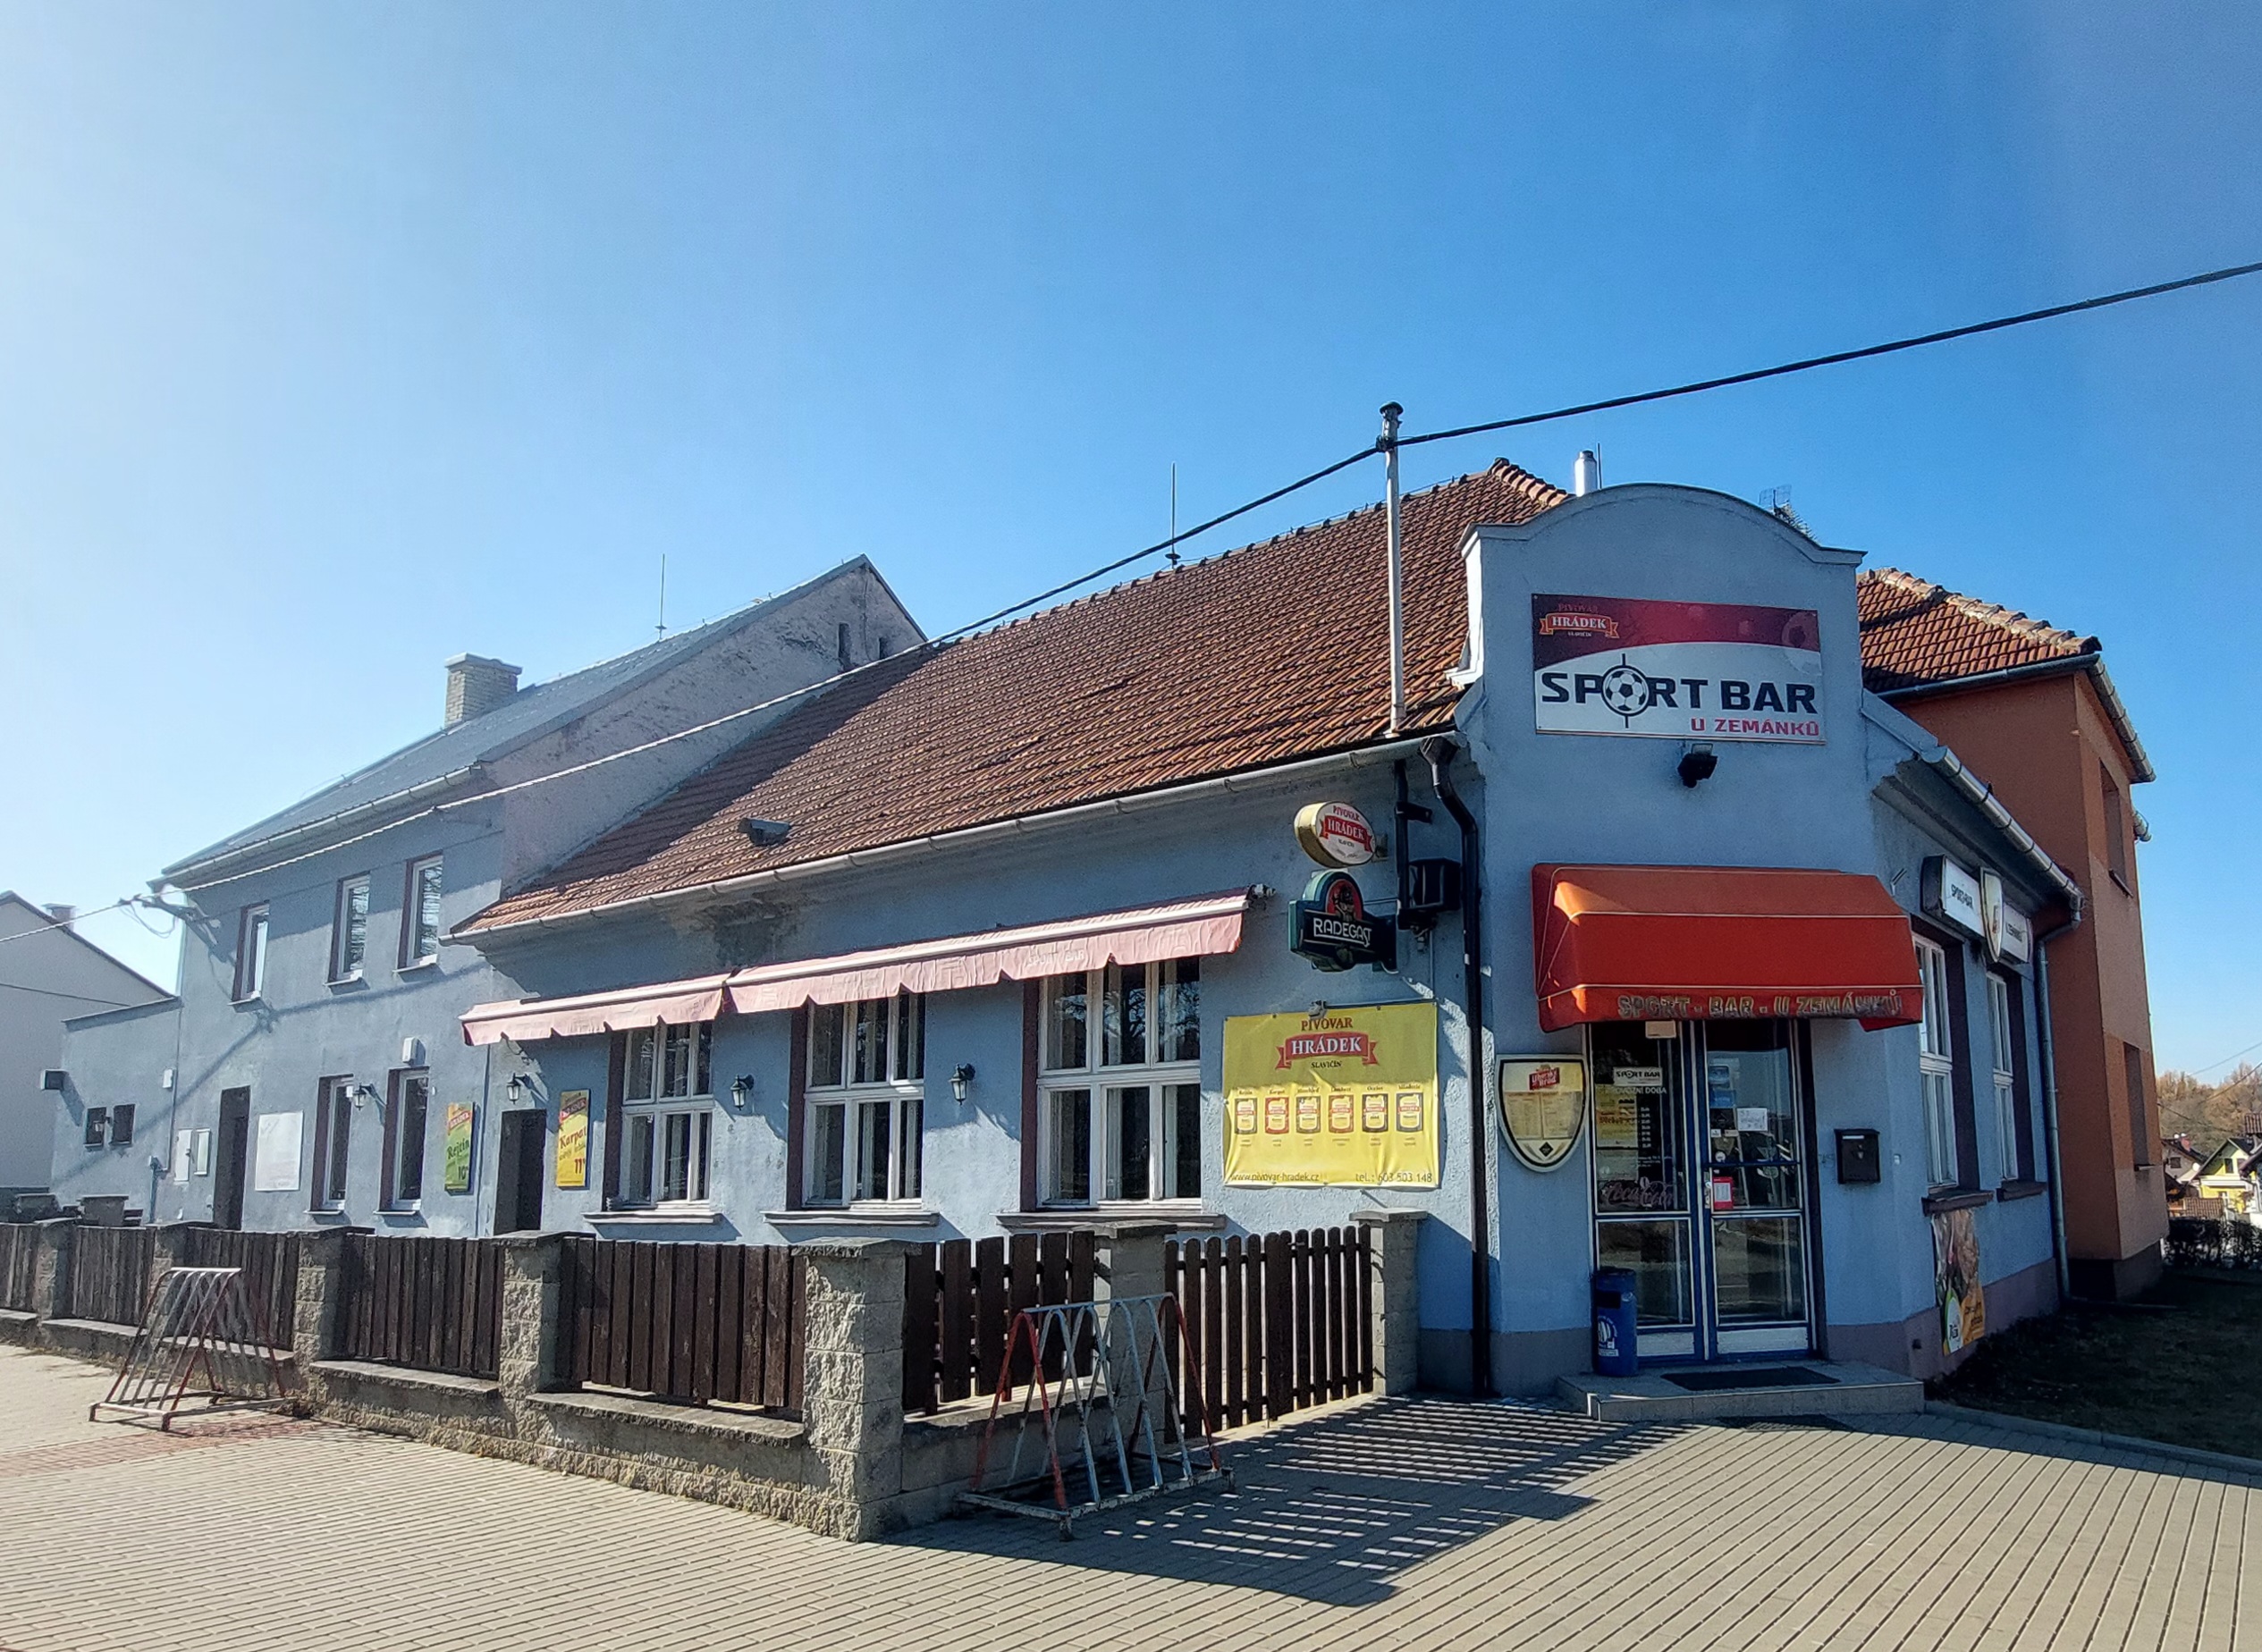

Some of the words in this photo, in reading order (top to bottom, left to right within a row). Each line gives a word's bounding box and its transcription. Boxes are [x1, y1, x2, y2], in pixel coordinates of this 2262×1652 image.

[1551, 616, 1607, 629] HRÁDEK
[1720, 679, 1819, 714] BAR
[1690, 718, 1706, 731] U
[1328, 819, 1364, 840] HRÁDEK
[1313, 917, 1372, 947] RADEGAST
[1617, 995, 1691, 1019] SPORT
[1709, 996, 1755, 1019] BAR
[1774, 996, 1789, 1016] U
[1301, 1017, 1353, 1031] PIVOVAR
[1291, 1035, 1362, 1055] HRÁDEK
[1378, 1173, 1394, 1183] 603
[1397, 1173, 1413, 1183] 503
[1416, 1173, 1432, 1183] 148
